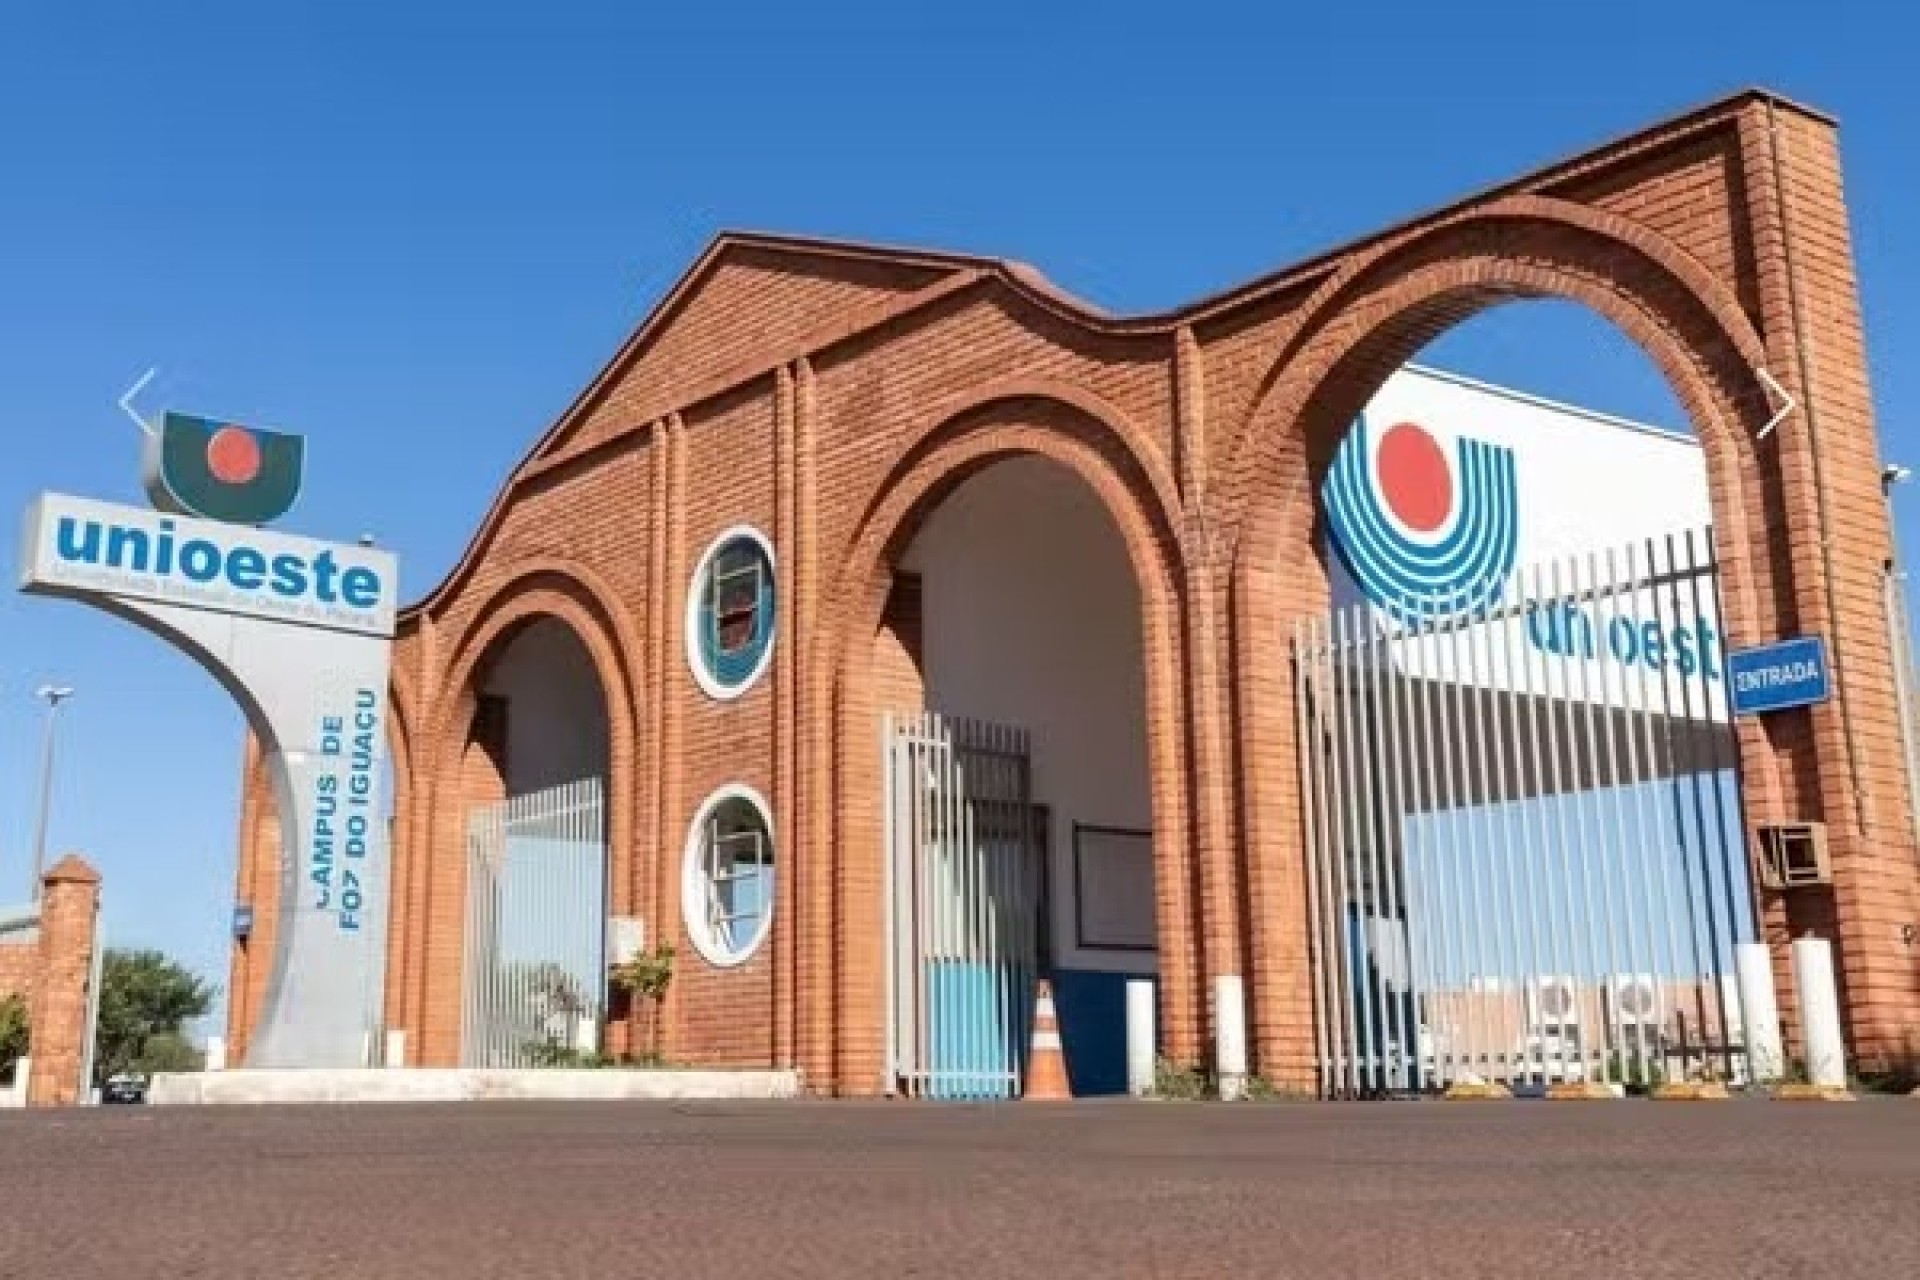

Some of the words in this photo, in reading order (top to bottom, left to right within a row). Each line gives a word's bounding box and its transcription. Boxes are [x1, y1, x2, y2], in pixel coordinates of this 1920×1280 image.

[57, 517, 381, 609] unioeste
[1737, 659, 1819, 692] ENTRADA
[322, 716, 343, 756] DE
[346, 815, 367, 858] DO
